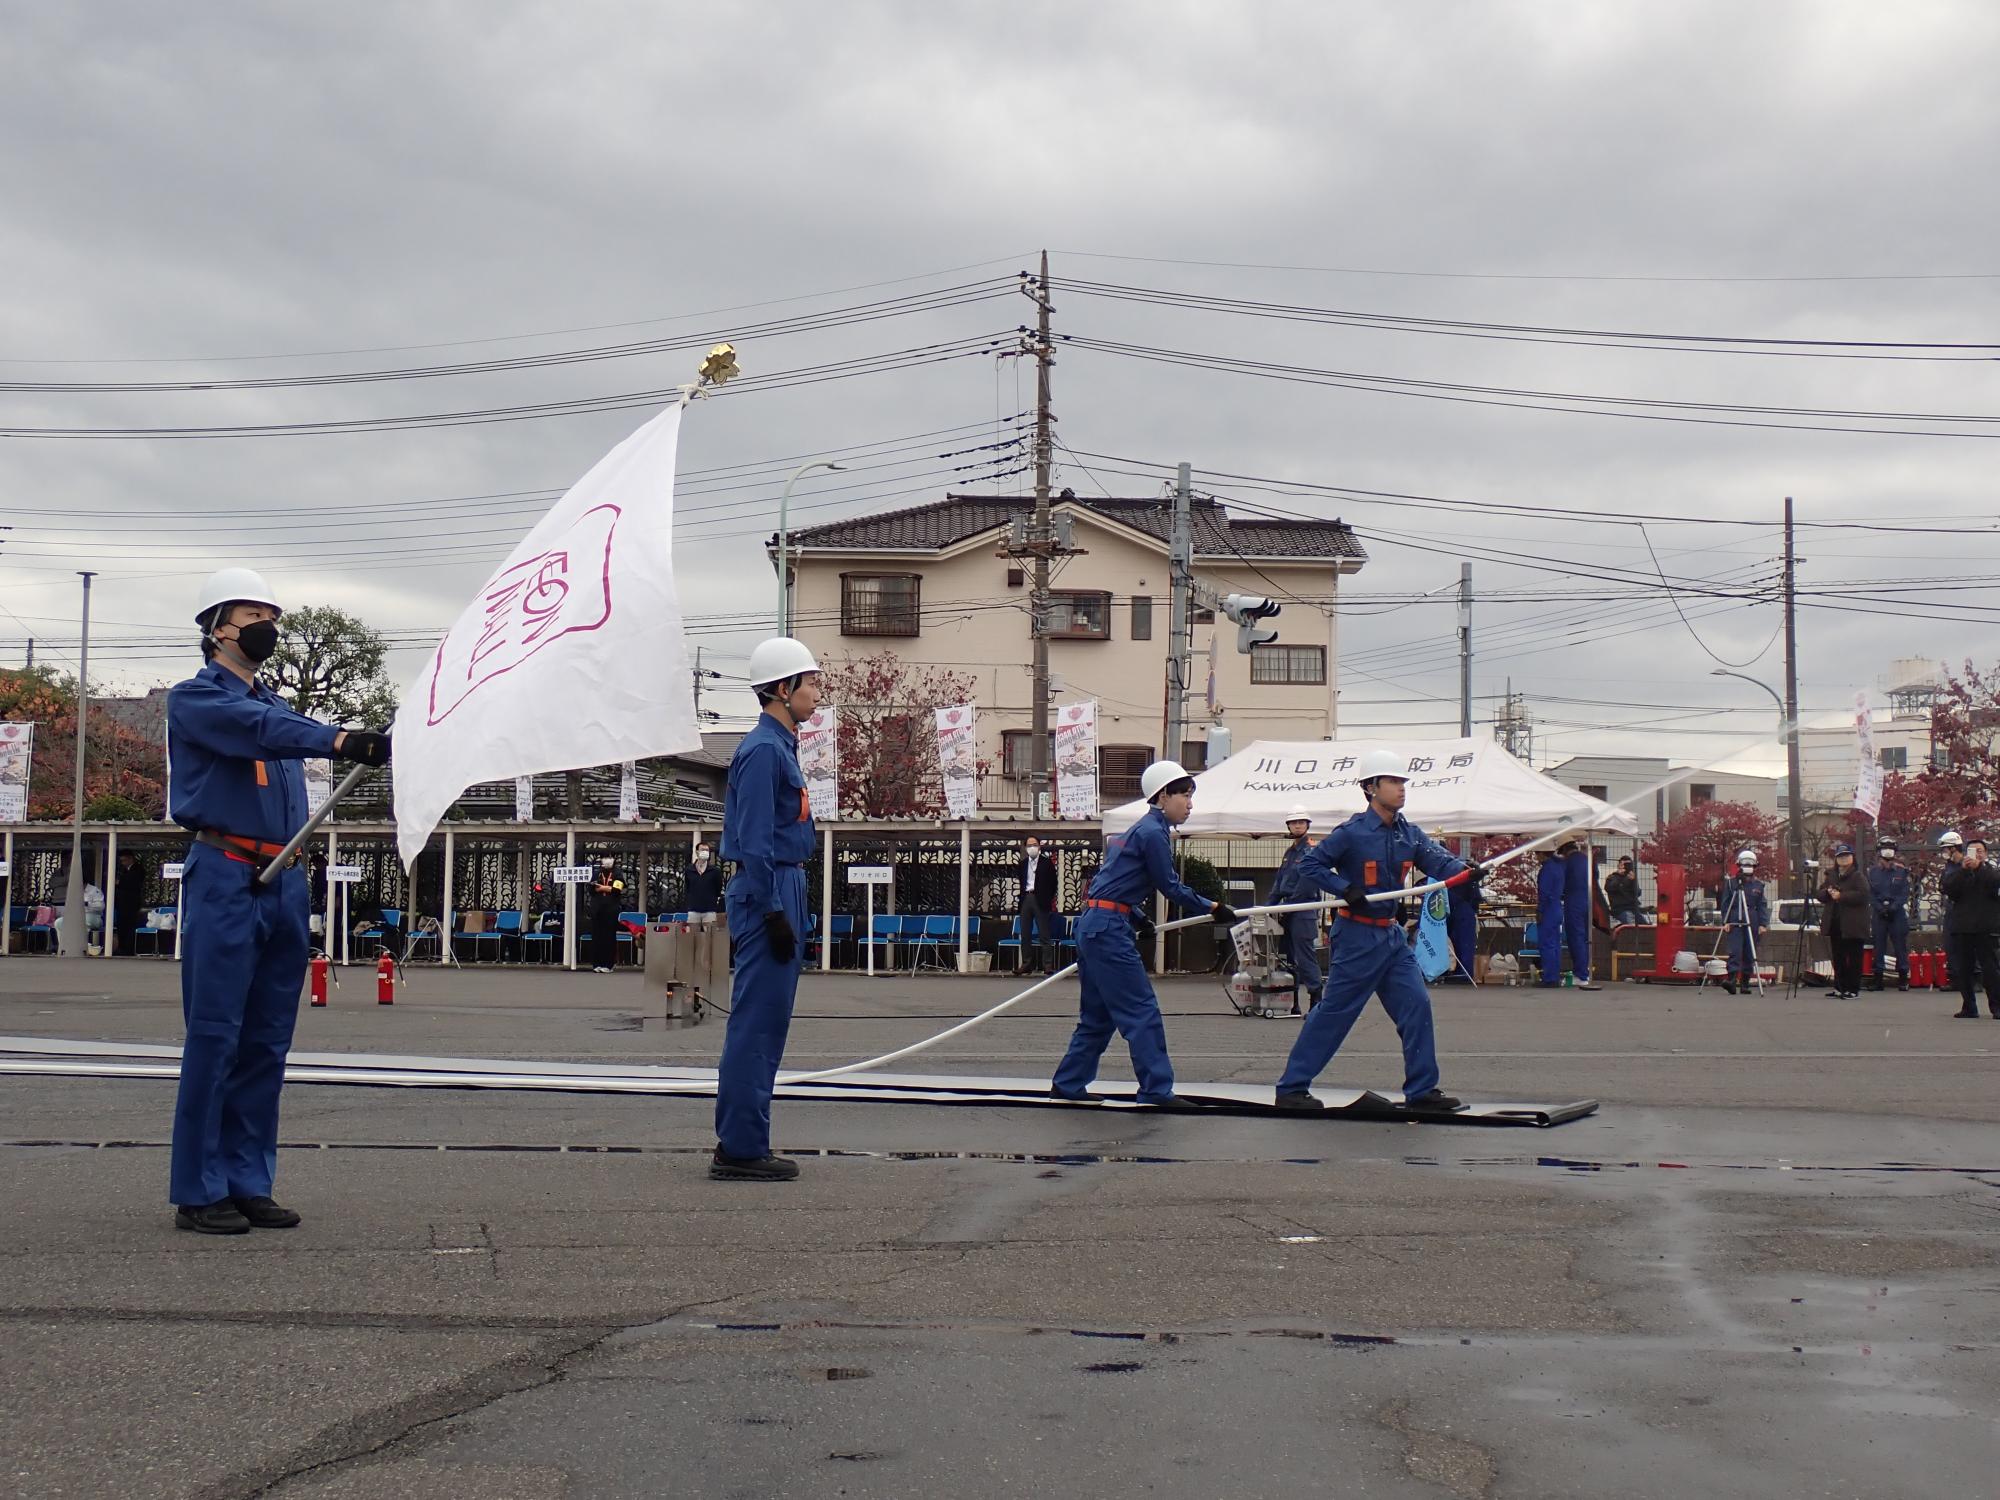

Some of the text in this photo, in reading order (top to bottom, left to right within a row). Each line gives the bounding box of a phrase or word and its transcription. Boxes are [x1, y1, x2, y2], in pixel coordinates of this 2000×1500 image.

[1254, 752, 1474, 774] 川口市防局
